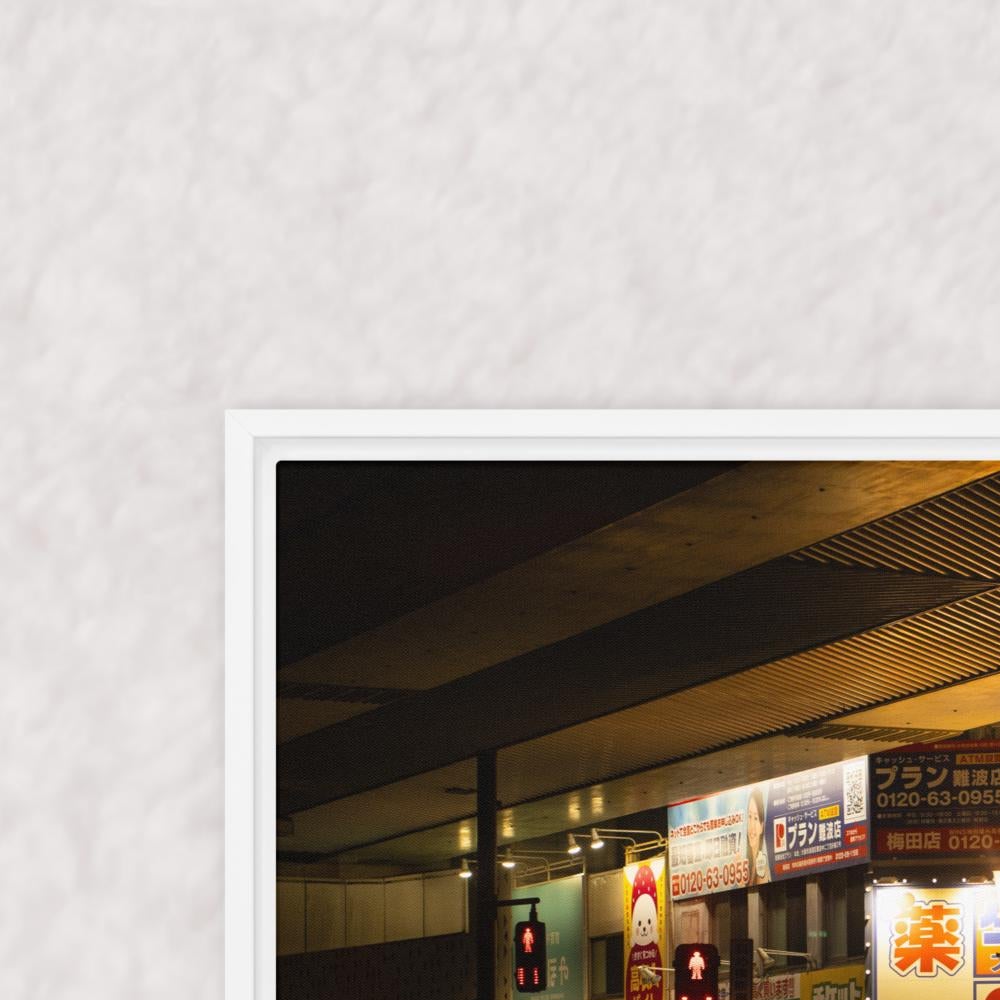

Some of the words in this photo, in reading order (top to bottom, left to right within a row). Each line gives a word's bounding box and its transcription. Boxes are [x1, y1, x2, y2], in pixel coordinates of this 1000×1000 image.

[886, 832, 941, 850] 梅田店
[680, 859, 750, 895] 0120-63-0955
[892, 902, 962, 974] 薬
